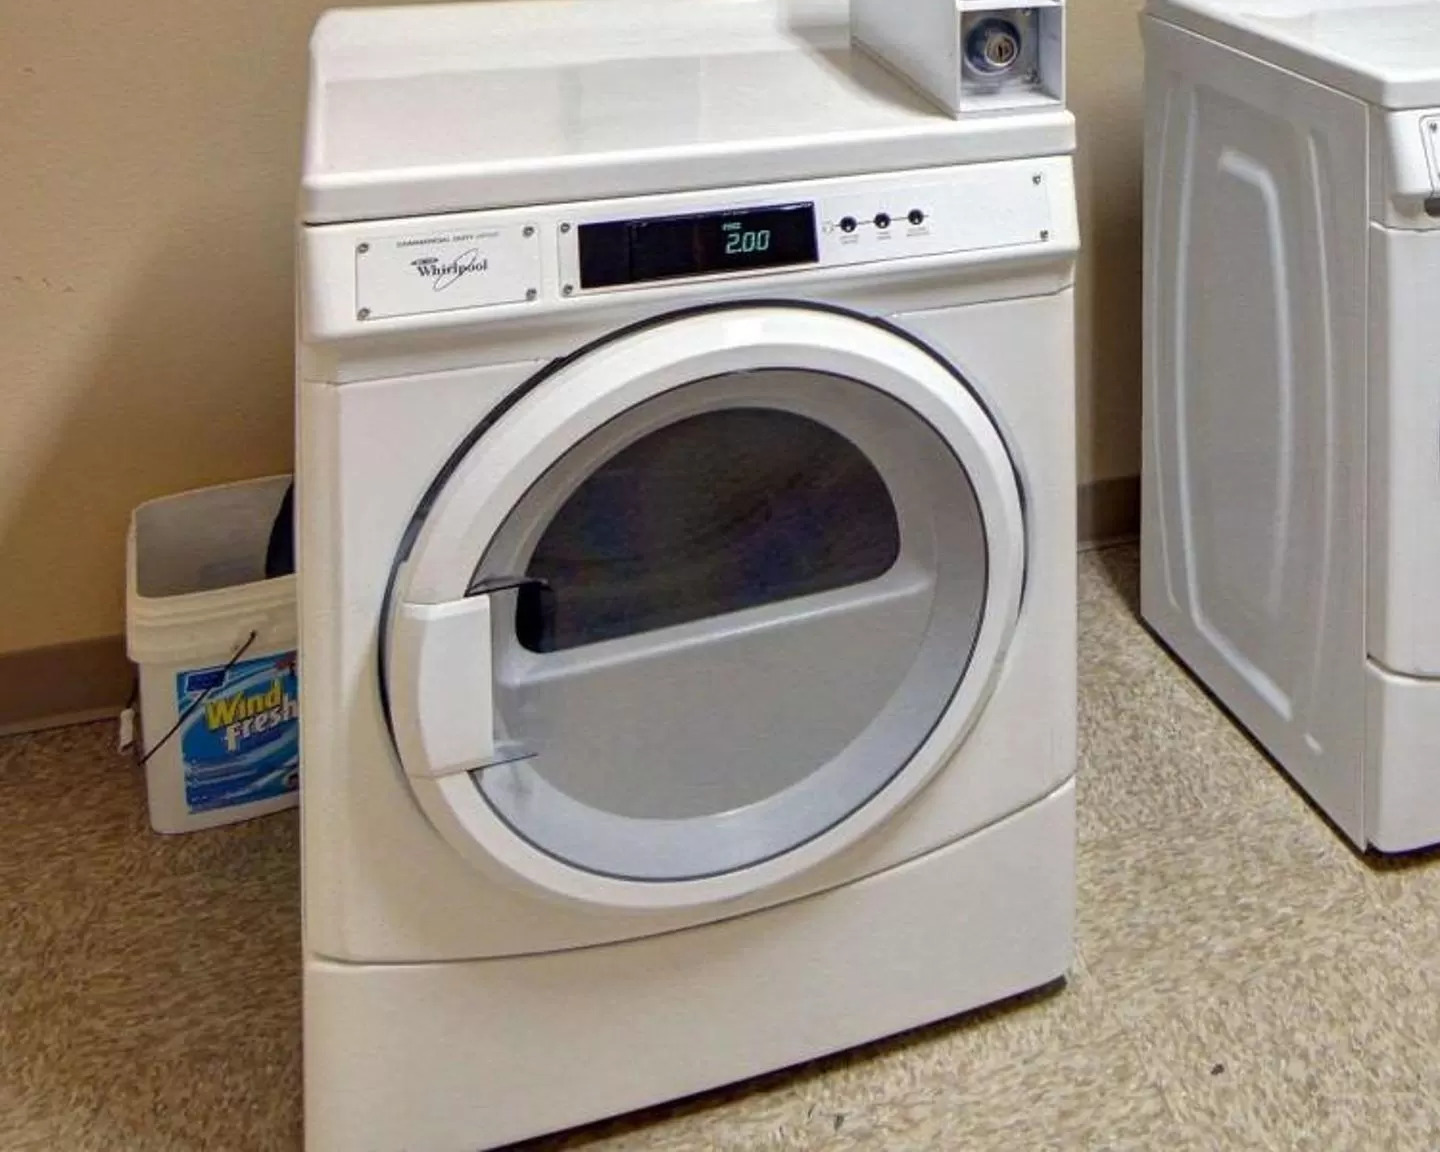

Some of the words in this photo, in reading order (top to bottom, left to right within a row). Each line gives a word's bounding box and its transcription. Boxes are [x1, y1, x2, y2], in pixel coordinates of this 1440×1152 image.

[725, 229, 771, 254] 2.00
[416, 258, 489, 278] Whirlpool
[206, 678, 285, 733] Wind
[226, 693, 298, 753] Fresh
